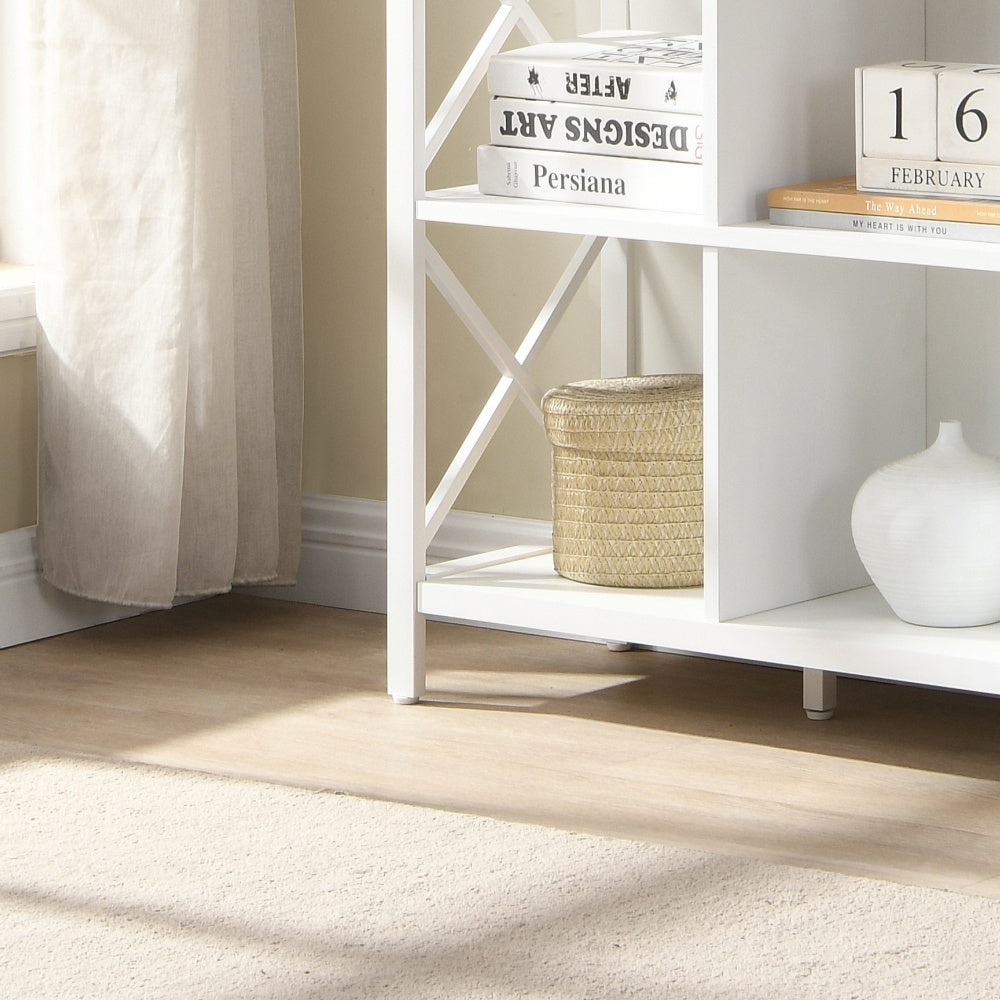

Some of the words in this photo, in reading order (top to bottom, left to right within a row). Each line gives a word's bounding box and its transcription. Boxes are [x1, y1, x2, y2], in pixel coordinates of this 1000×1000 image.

[565, 71, 632, 100] AFTER
[499, 110, 558, 140] ART
[888, 87, 909, 141] 1
[955, 88, 989, 143] 6
[565, 115, 689, 152] DESIGNS
[533, 164, 626, 196] Persiana
[891, 166, 986, 189] FEBRUARY
[865, 200, 882, 212] The
[884, 201, 905, 216] Way
[909, 203, 938, 217] Ahead
[853, 219, 864, 228] MY
[867, 220, 894, 231] HEART
[896, 222, 905, 231] IS
[907, 223, 928, 234] WITH
[930, 226, 948, 236] YOU
